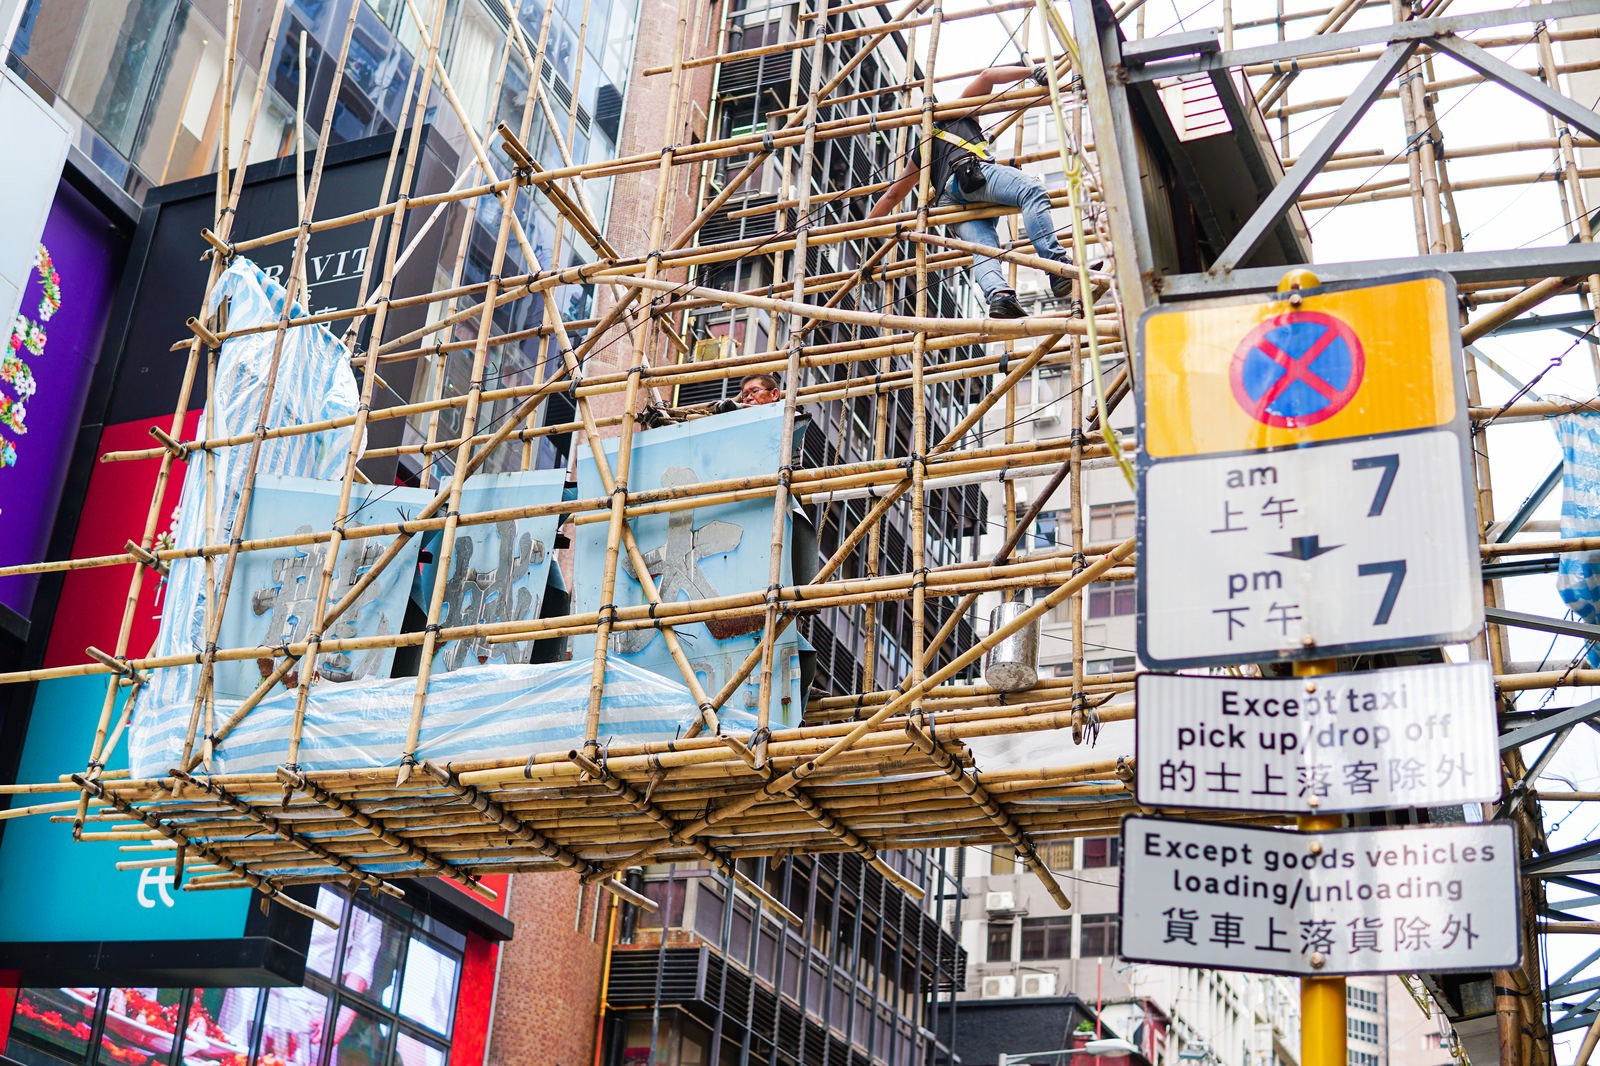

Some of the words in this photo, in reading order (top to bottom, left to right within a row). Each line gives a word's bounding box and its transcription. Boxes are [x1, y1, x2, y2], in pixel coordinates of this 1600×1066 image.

[1226, 465, 1278, 488] am
[1352, 453, 1400, 518] 7
[1210, 496, 1298, 534] 上午
[1228, 569, 1283, 599] pm
[1357, 559, 1408, 626] 7
[1211, 602, 1303, 641] 下午
[1221, 690, 1337, 722] Except
[1346, 684, 1410, 714] taxi
[1177, 722, 1247, 750] pick
[1258, 721, 1392, 755] up/drop
[1405, 713, 1453, 741] off
[1159, 752, 1474, 798] 的士上落客除外
[1144, 832, 1254, 868] Except
[1263, 847, 1356, 873] goods
[1365, 841, 1496, 869] vehicles
[1173, 868, 1464, 910] loading/unloading
[1161, 906, 1480, 955] 貨車上落貨除外
